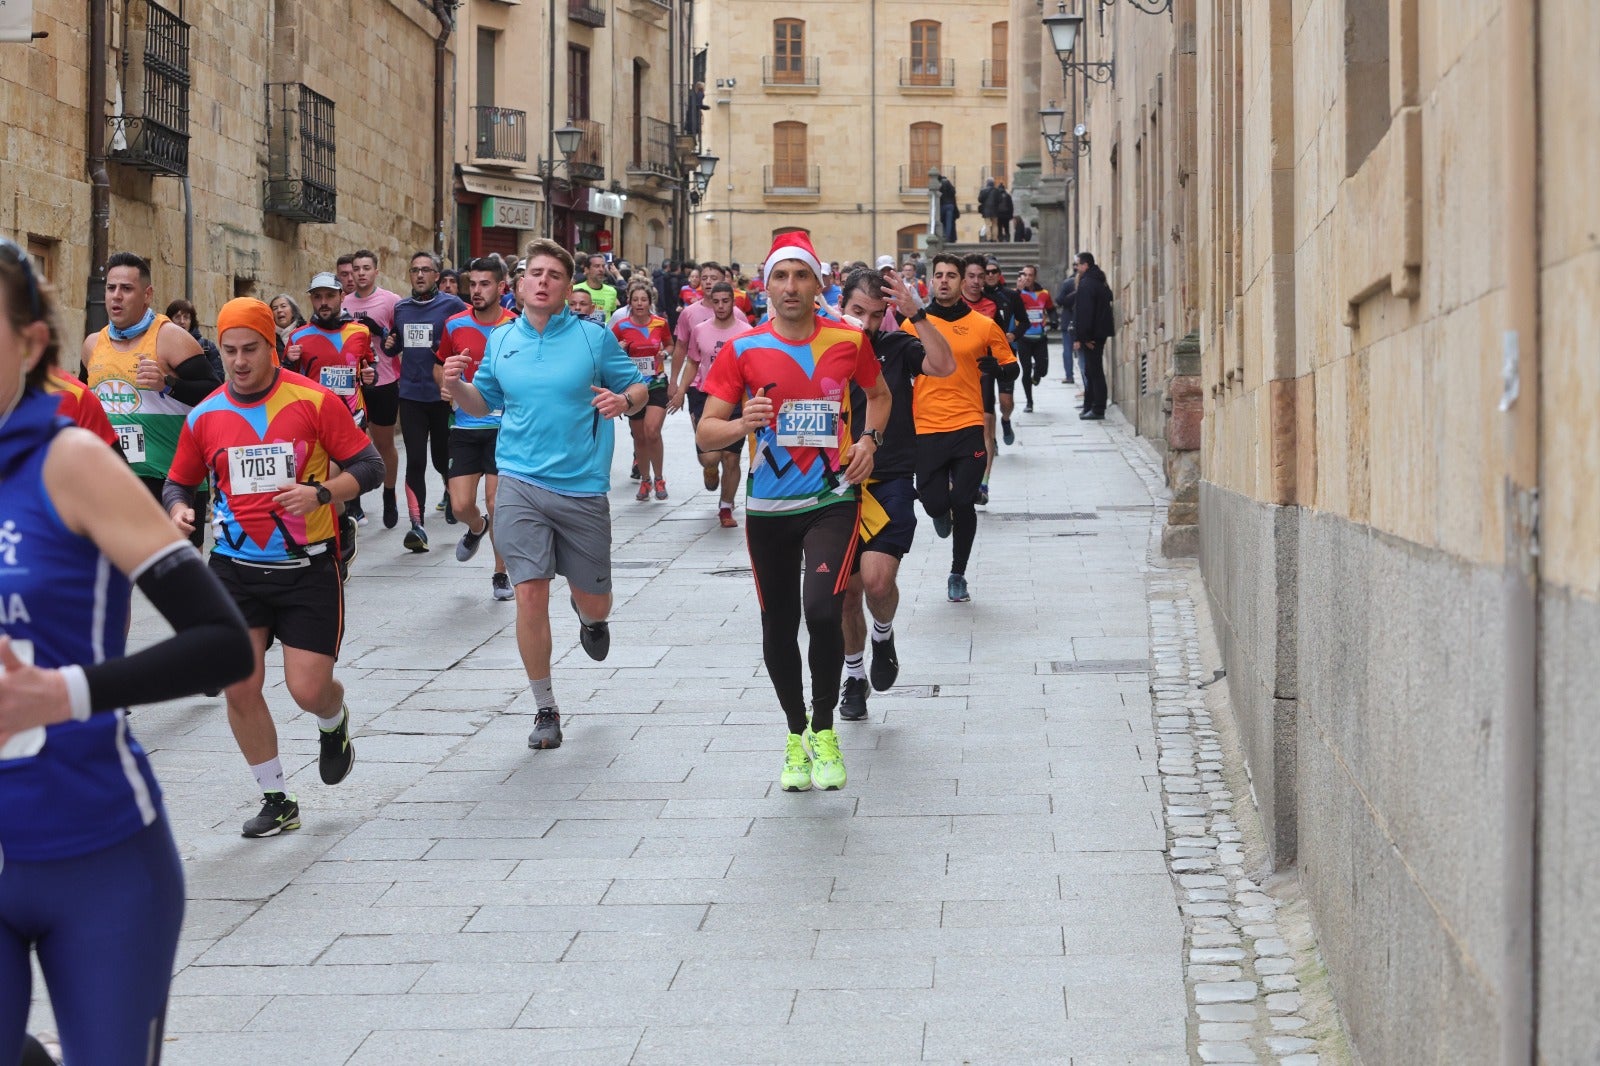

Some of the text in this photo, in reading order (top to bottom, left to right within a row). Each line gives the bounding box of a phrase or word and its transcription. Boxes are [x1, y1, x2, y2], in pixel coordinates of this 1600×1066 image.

[499, 206, 529, 226] SCALE
[408, 330, 424, 340] 1576
[326, 374, 347, 387] 3718
[794, 403, 834, 412] SETEL
[785, 413, 826, 432] 3220
[113, 426, 138, 434] ETEL
[245, 446, 287, 457] SETEL
[240, 456, 276, 478] 1703
